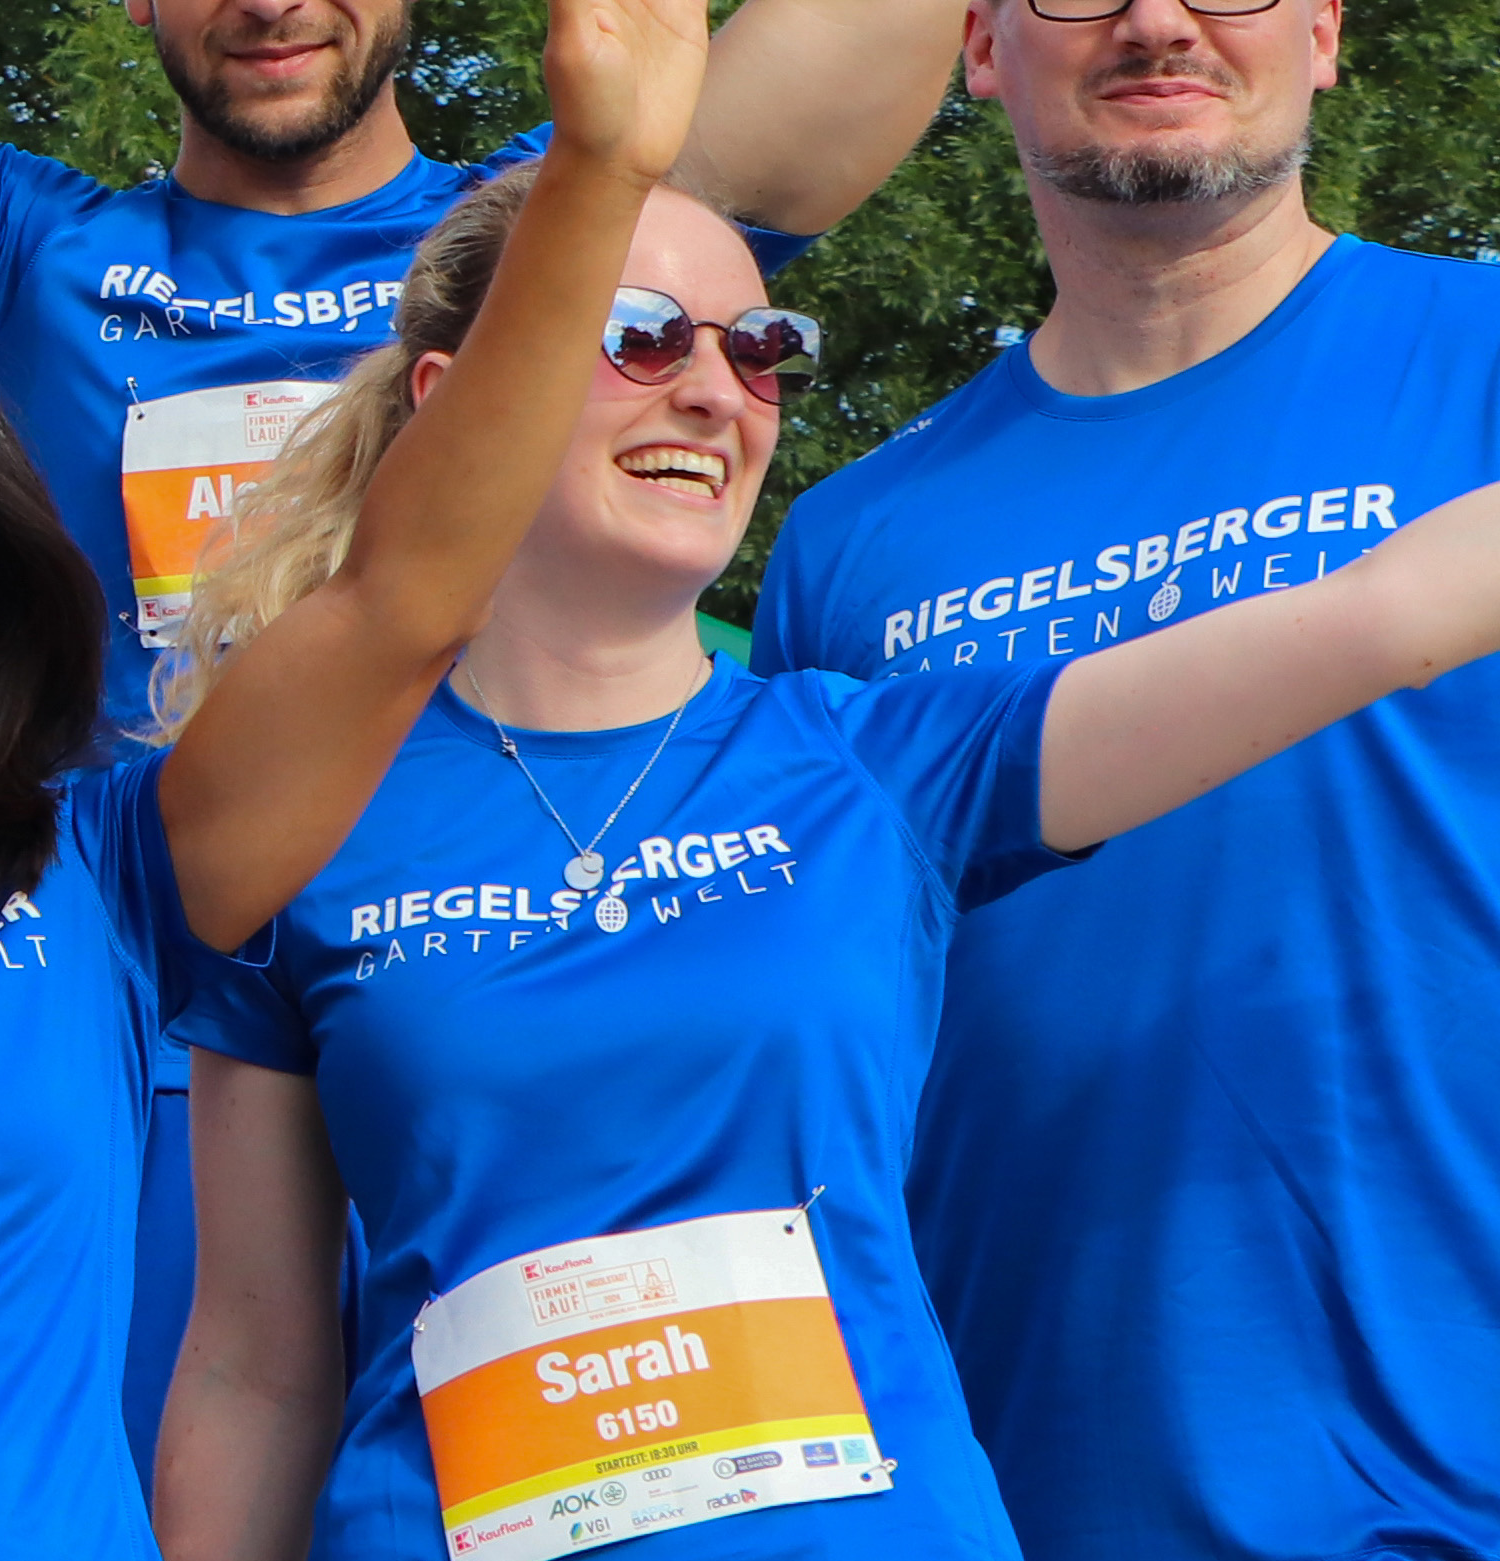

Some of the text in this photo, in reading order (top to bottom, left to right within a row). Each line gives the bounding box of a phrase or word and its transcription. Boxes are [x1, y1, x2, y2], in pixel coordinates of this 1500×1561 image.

[249, 414, 286, 426] FIRMEN
[651, 860, 797, 924] WELT
[544, 1255, 594, 1274] Kaufland
[534, 1282, 577, 1302] FIRMEN
[537, 1295, 580, 1320] LAUF
[536, 1325, 710, 1404] Sarah
[597, 1400, 678, 1441] 6150
[595, 1441, 699, 1474] STARTZEIT: 18:30 UHR
[477, 1515, 534, 1543] Kaufland
[549, 1489, 599, 1520] AOK
[585, 1517, 610, 1534] VGI
[632, 1507, 685, 1526] GALAXY
